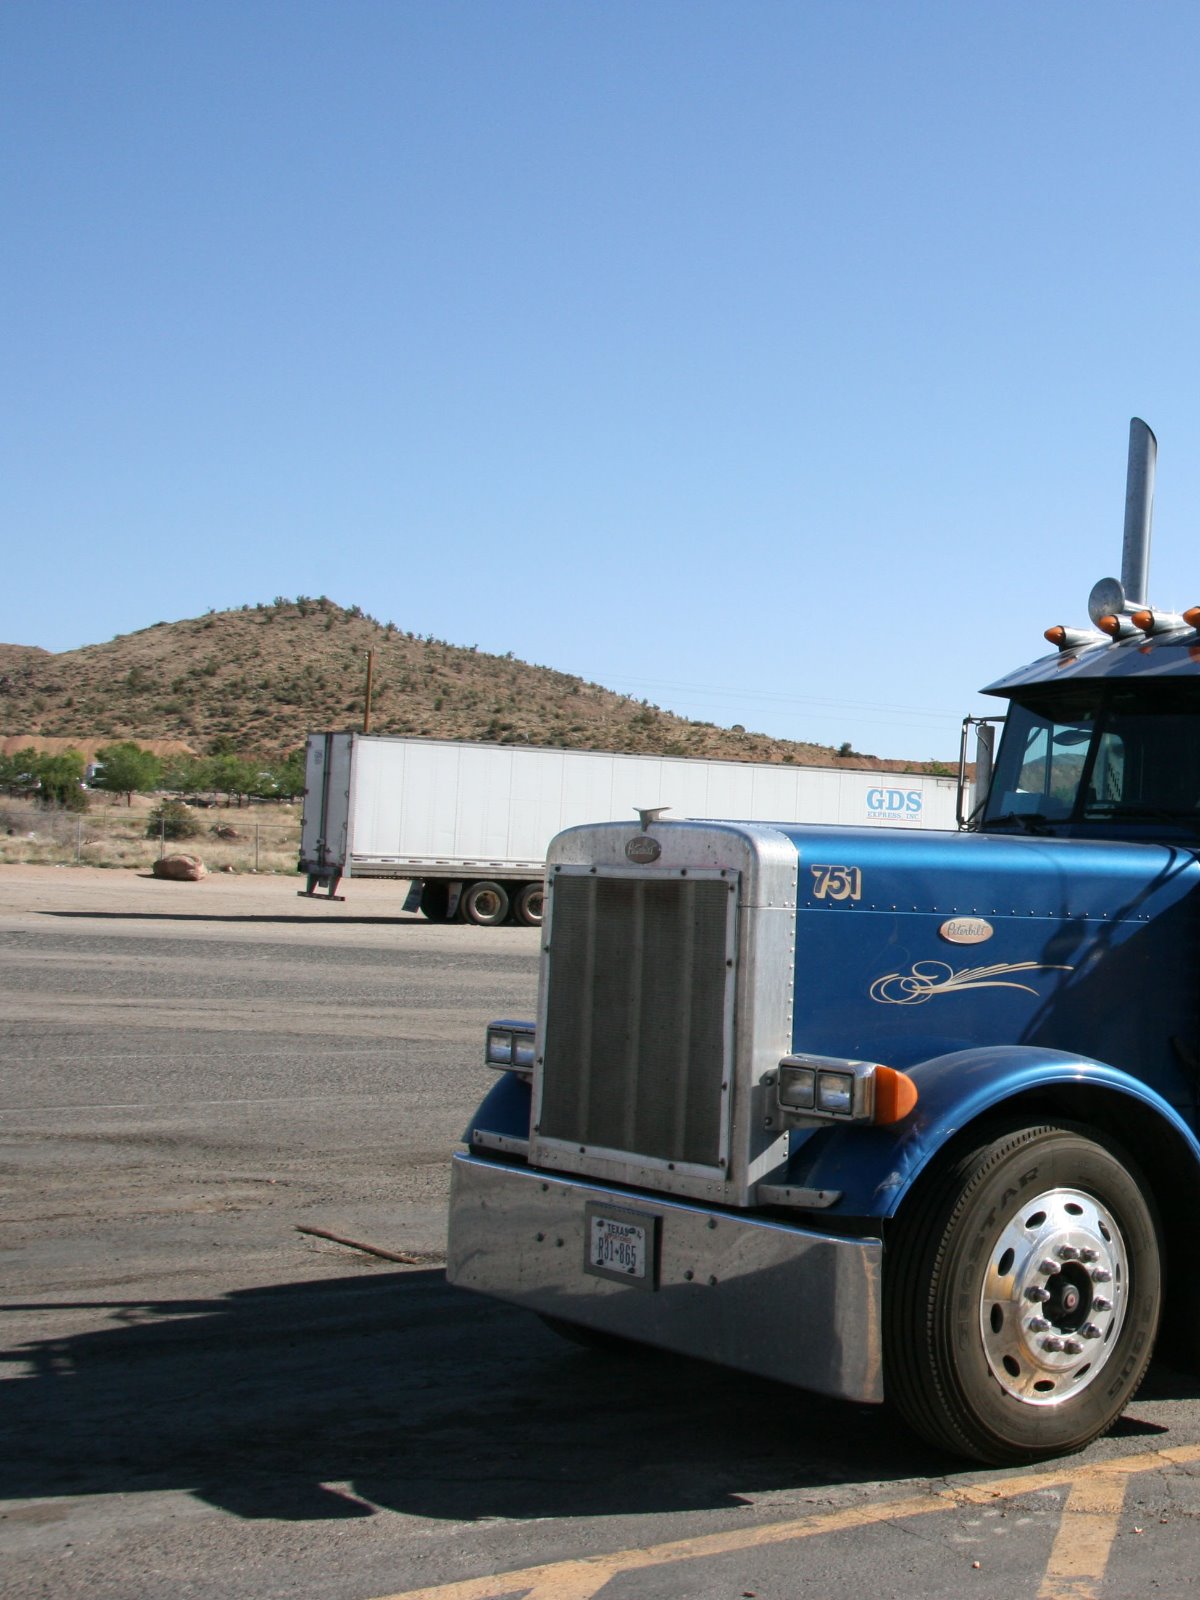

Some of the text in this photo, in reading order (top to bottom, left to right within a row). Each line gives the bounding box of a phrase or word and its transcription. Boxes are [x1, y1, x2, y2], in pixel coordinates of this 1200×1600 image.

[866, 788, 923, 812] GDS
[867, 811, 902, 819] EXPRESS
[810, 864, 861, 900] 751
[947, 921, 989, 936] Peterbilt
[607, 1222, 630, 1237] TEXAS
